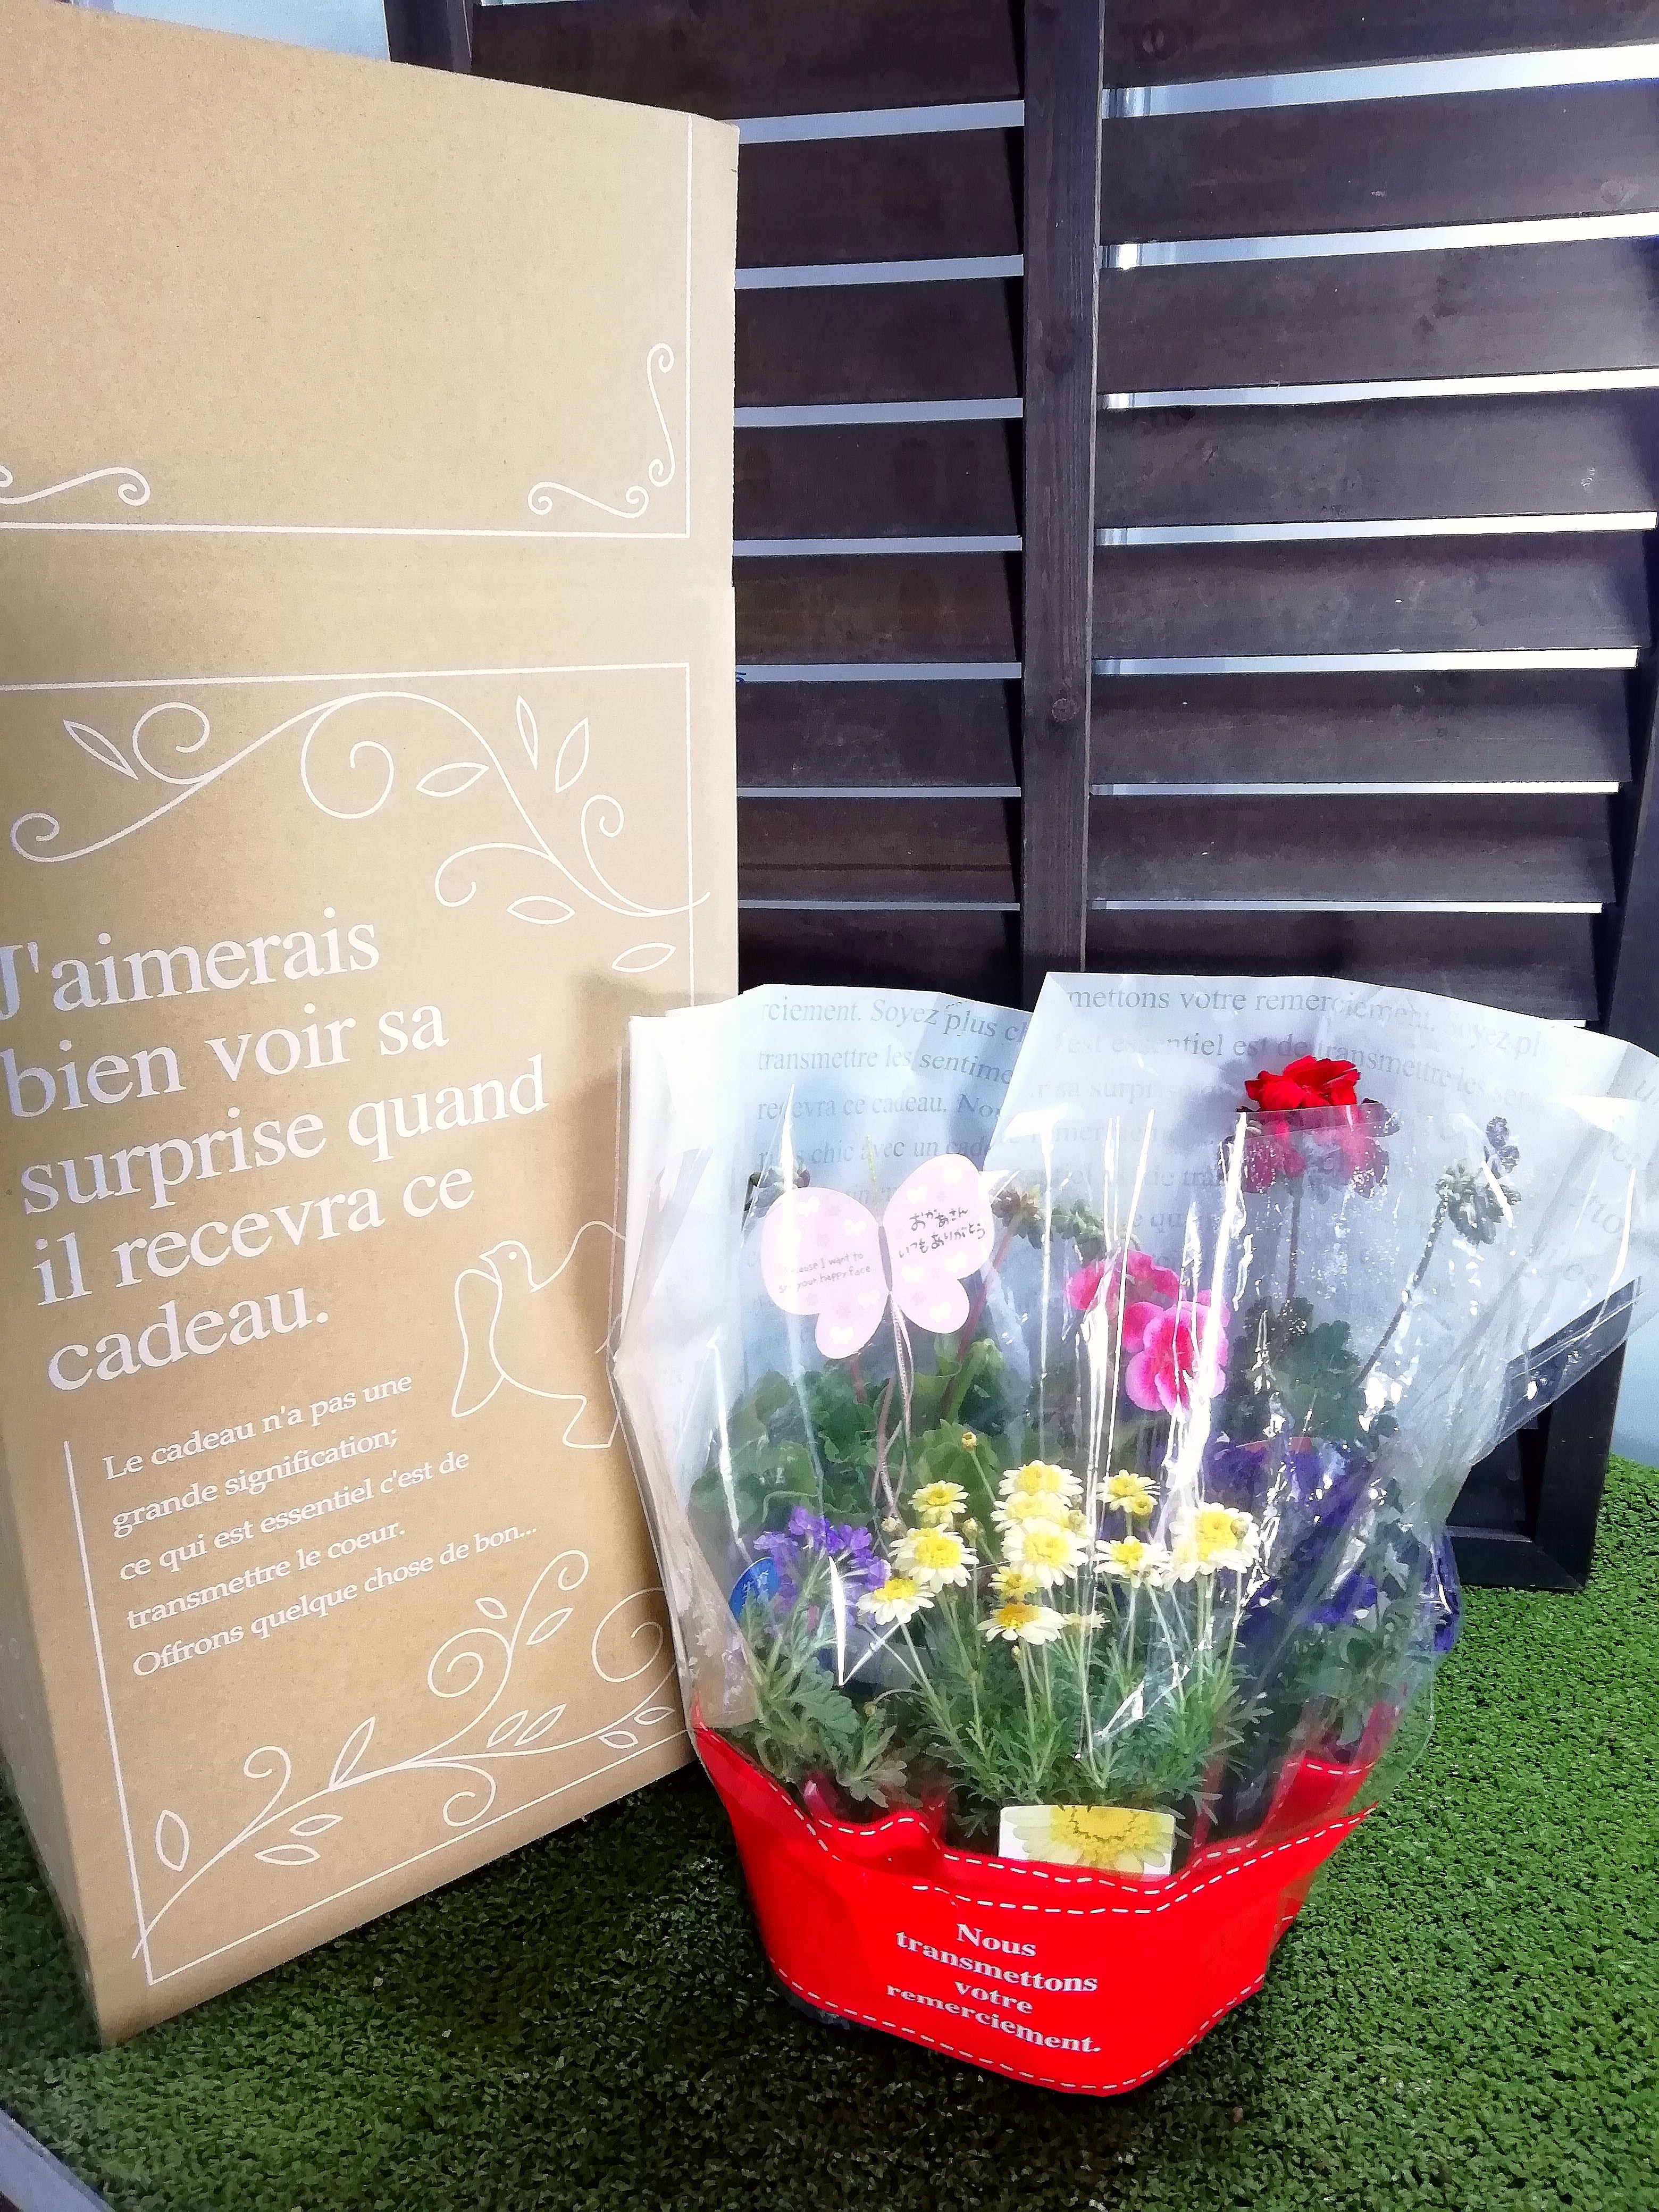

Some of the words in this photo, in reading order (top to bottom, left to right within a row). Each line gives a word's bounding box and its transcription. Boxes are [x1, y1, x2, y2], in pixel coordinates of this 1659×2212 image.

[0, 907, 380, 1021] J'aimerais
[870, 999, 938, 1027] Soyez
[943, 1010, 998, 1037] plus
[1179, 989, 1247, 1010] votre
[1, 1041, 187, 1118] bien
[205, 1003, 357, 1083] voir
[378, 1004, 450, 1058] sa
[759, 1046, 880, 1070] transmettre
[885, 1044, 912, 1067] les
[21, 1107, 327, 1215] surprise
[348, 1053, 549, 1163] quand
[843, 1099, 866, 1116] ce
[873, 1094, 947, 1115] cadeau.
[811, 1139, 854, 1164] chic
[914, 1141, 939, 1157] un
[32, 1231, 93, 1306] il
[112, 1186, 386, 1288] recevra
[403, 1168, 475, 1219] ce
[852, 1251, 864, 1261] to
[898, 1222, 986, 1258] いつもありがとう
[48, 1286, 330, 1392] cadeau.
[103, 1452, 144, 1480] Le
[150, 1421, 256, 1467] cadeau
[262, 1406, 303, 1434] n'a
[309, 1390, 357, 1429] pas
[362, 1374, 413, 1403] une
[112, 1481, 218, 1538] grande
[224, 1430, 398, 1495] signification;
[119, 1555, 152, 1581] ce
[159, 1533, 208, 1573] qui
[213, 1519, 254, 1549] est
[259, 1478, 373, 1535] essentiel
[379, 1461, 433, 1494] c'est
[438, 1448, 470, 1476] de
[126, 1558, 291, 1630] transmettre
[296, 1547, 321, 1571] le
[327, 1526, 406, 1560] coeur.
[132, 1623, 245, 1677] Offrons
[250, 1578, 358, 1639] quelque
[363, 1552, 433, 1591] chose
[438, 1539, 470, 1565] de
[472, 1523, 537, 1554] bon...
[895, 1930, 1099, 1992] transmettons
[955, 1922, 1036, 1957] Nous
[886, 1982, 1102, 2052] remerciement.
[954, 1980, 1034, 2014] votre
